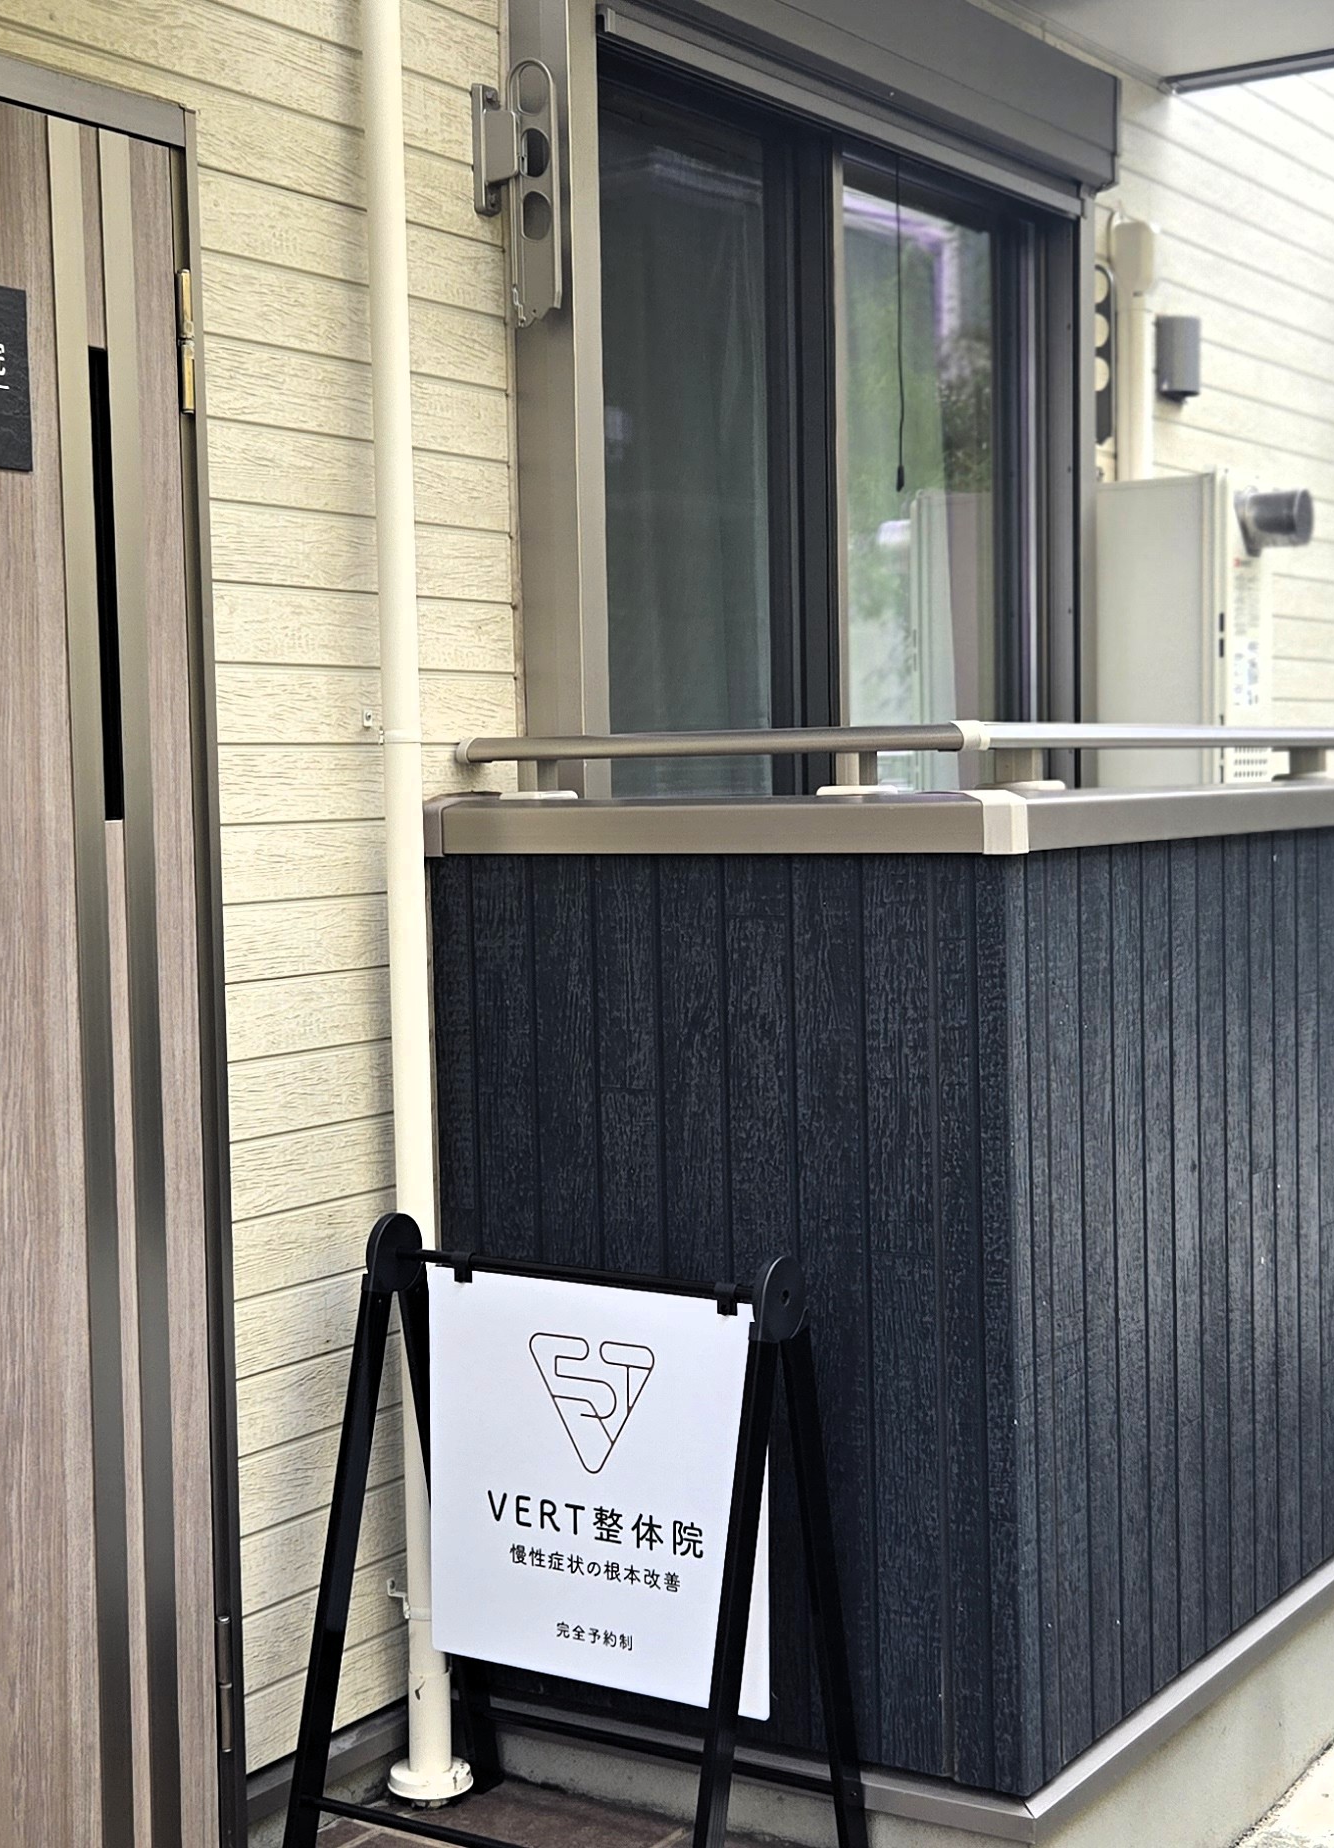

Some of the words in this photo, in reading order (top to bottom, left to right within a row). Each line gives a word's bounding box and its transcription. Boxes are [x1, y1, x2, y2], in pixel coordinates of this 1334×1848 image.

[509, 1543, 682, 1593] 慢性症状の根本改善
[555, 1621, 634, 1652] 完全予約制
